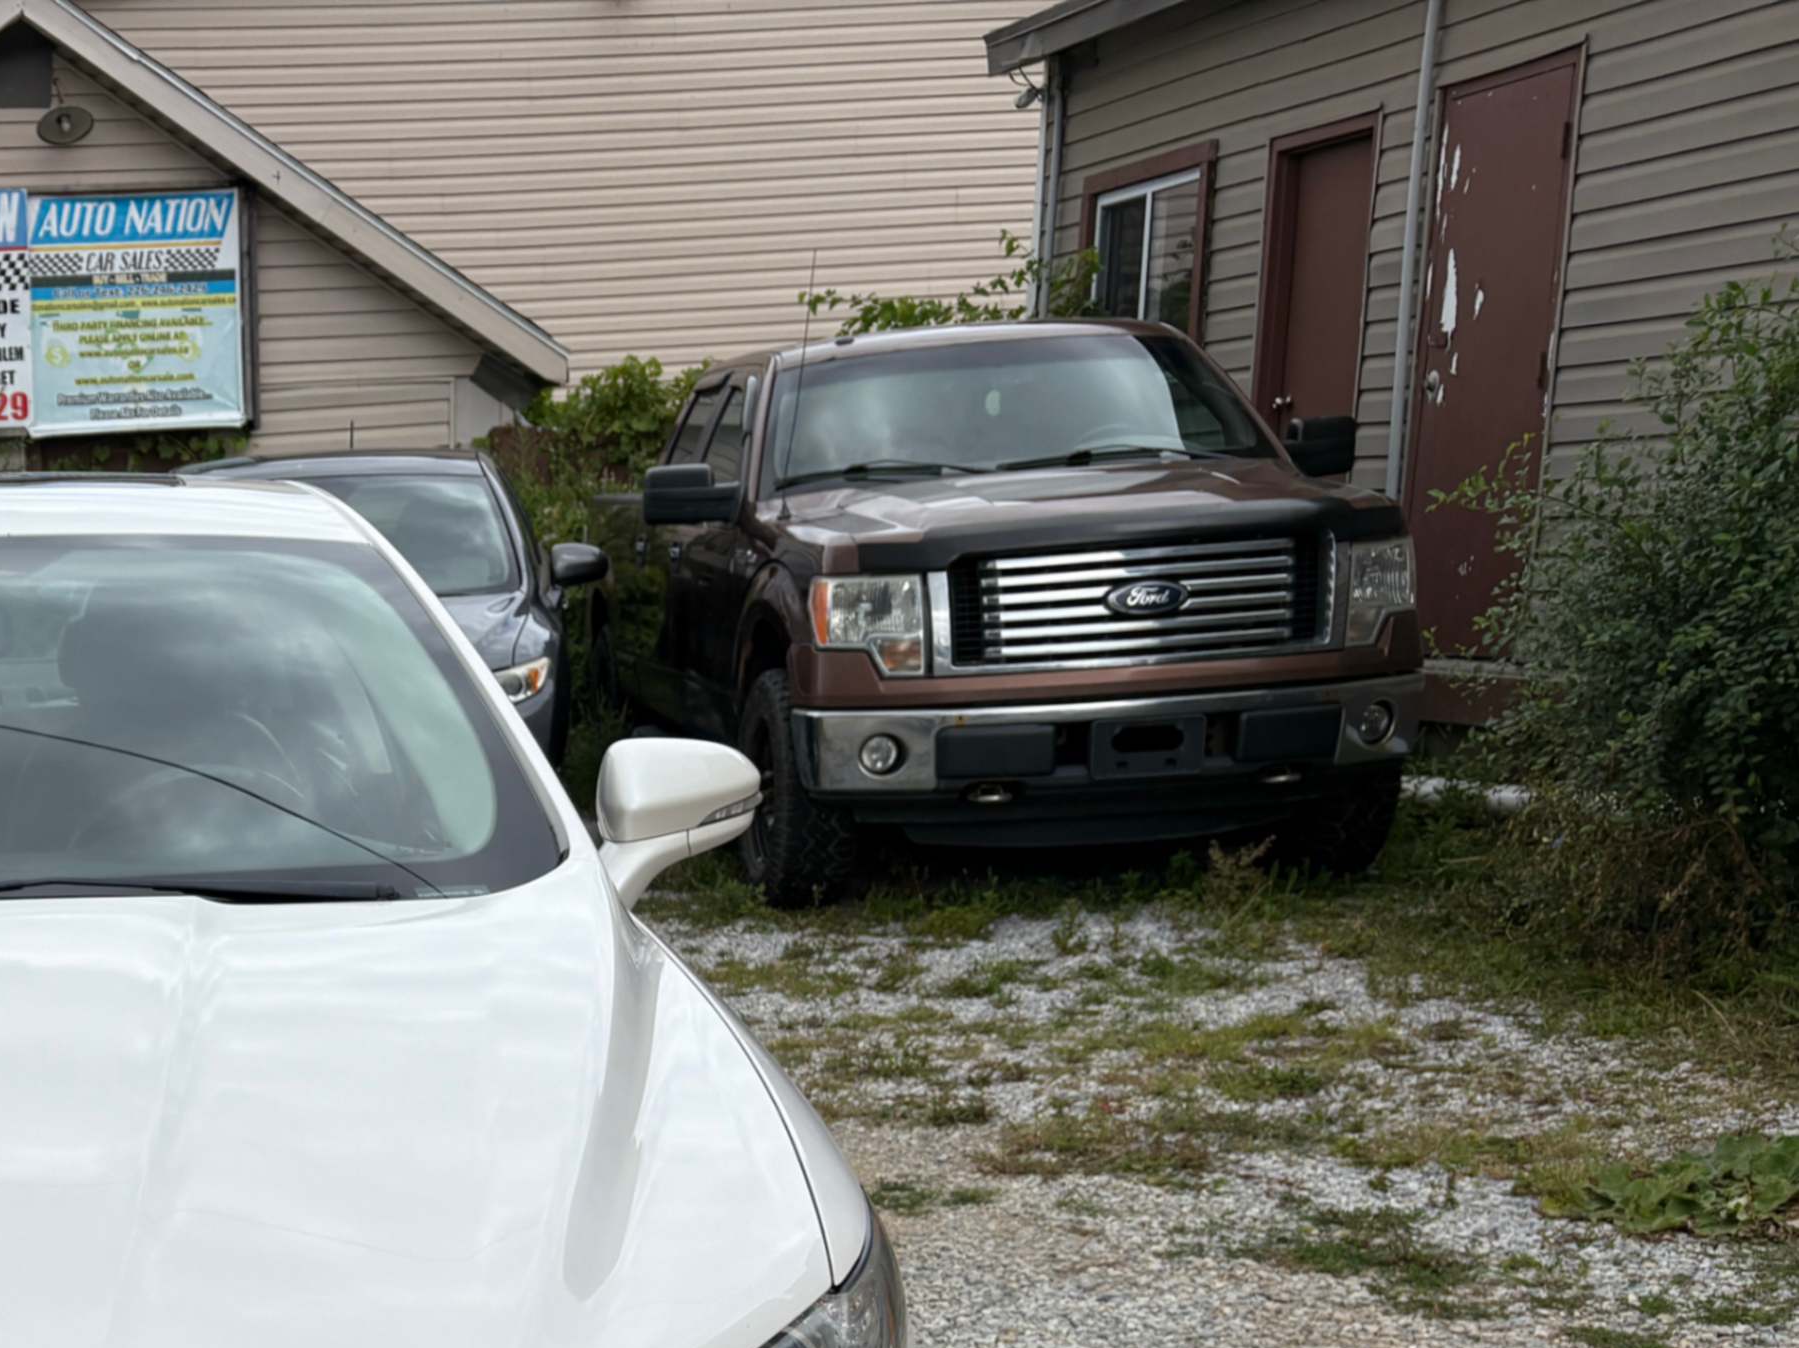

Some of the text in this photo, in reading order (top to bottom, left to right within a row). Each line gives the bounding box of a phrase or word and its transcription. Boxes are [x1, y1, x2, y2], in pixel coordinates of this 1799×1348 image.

[38, 197, 229, 238] AUTO NATION
[86, 249, 165, 272] CAR SALES
[79, 334, 109, 345] PLEASE
[1127, 587, 1170, 606] Ford
